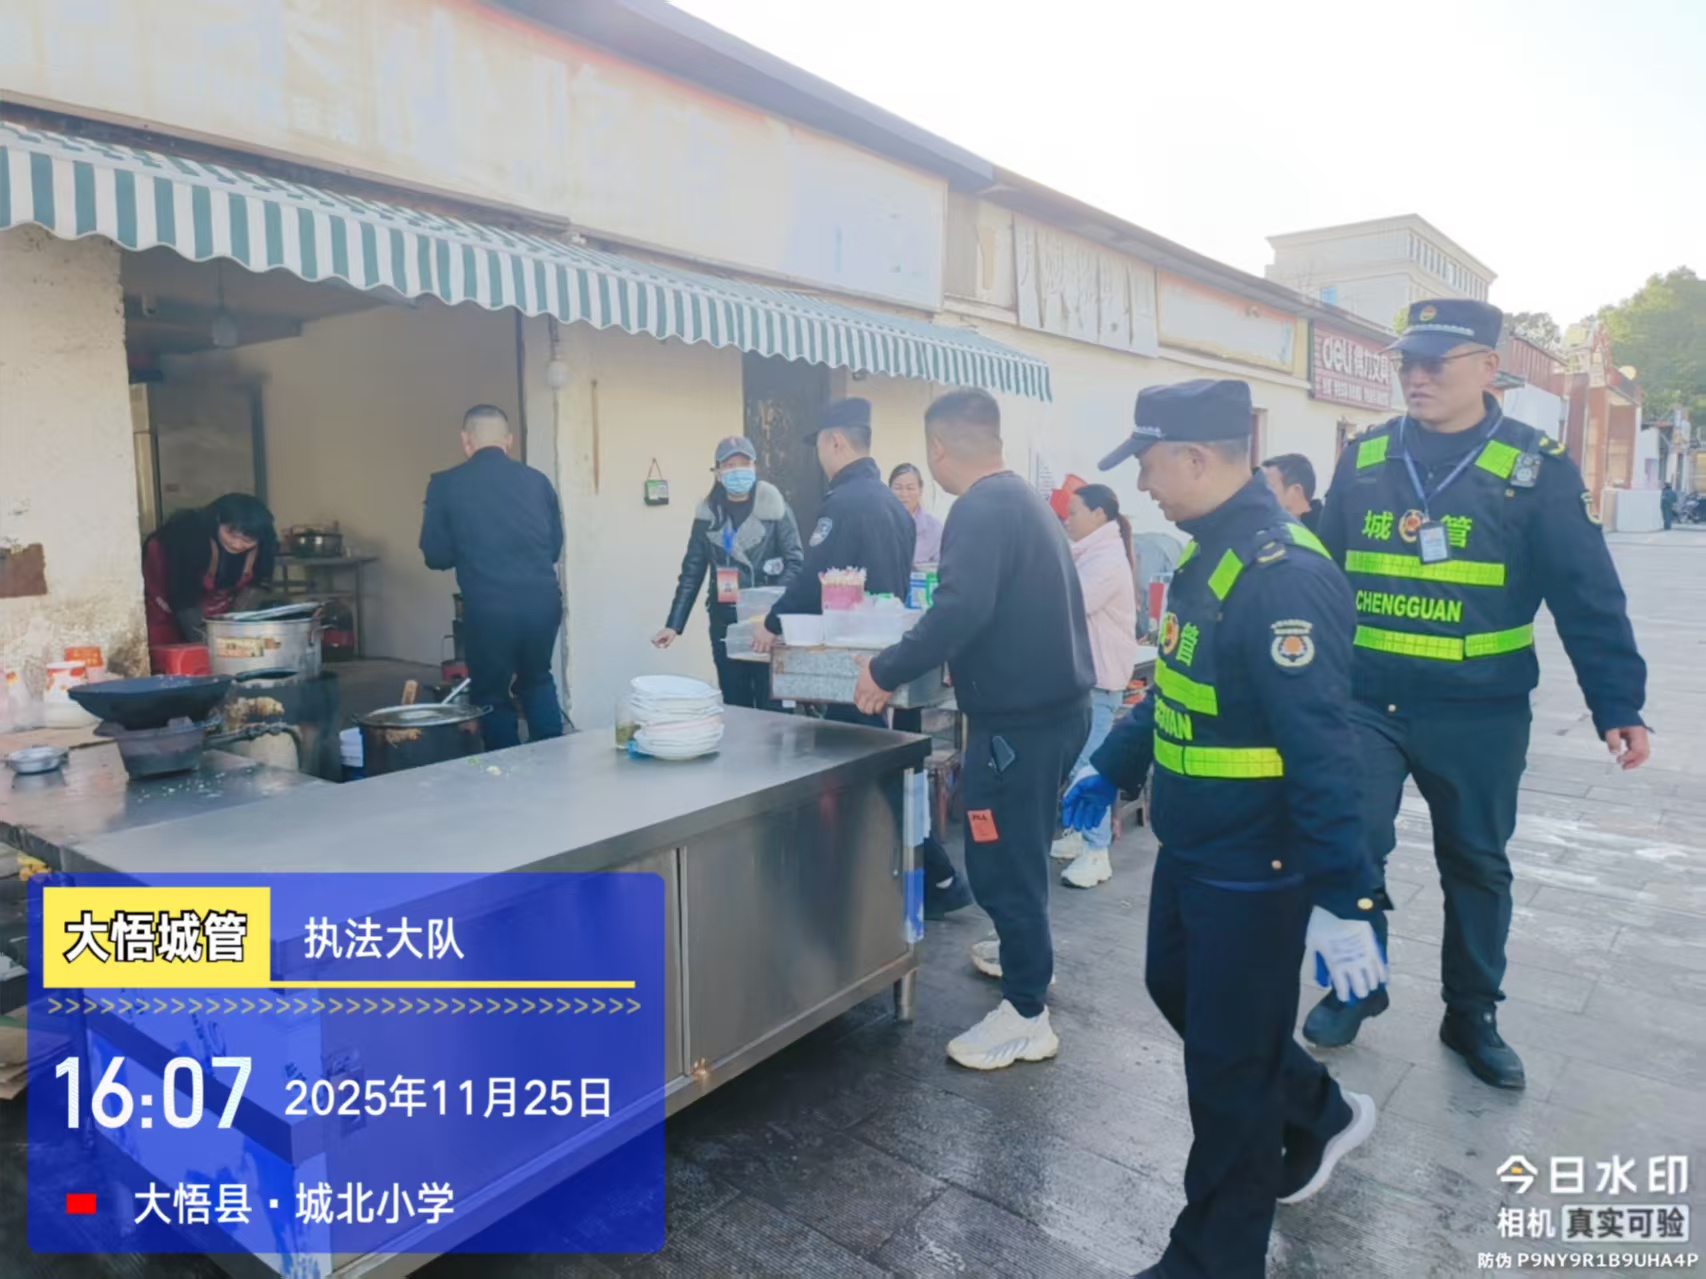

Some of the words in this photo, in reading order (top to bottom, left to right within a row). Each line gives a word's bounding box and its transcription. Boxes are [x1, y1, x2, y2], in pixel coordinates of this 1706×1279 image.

[1361, 509, 1394, 541] 城
[1440, 514, 1473, 548] 管
[1355, 589, 1463, 622] CHENGGUAN
